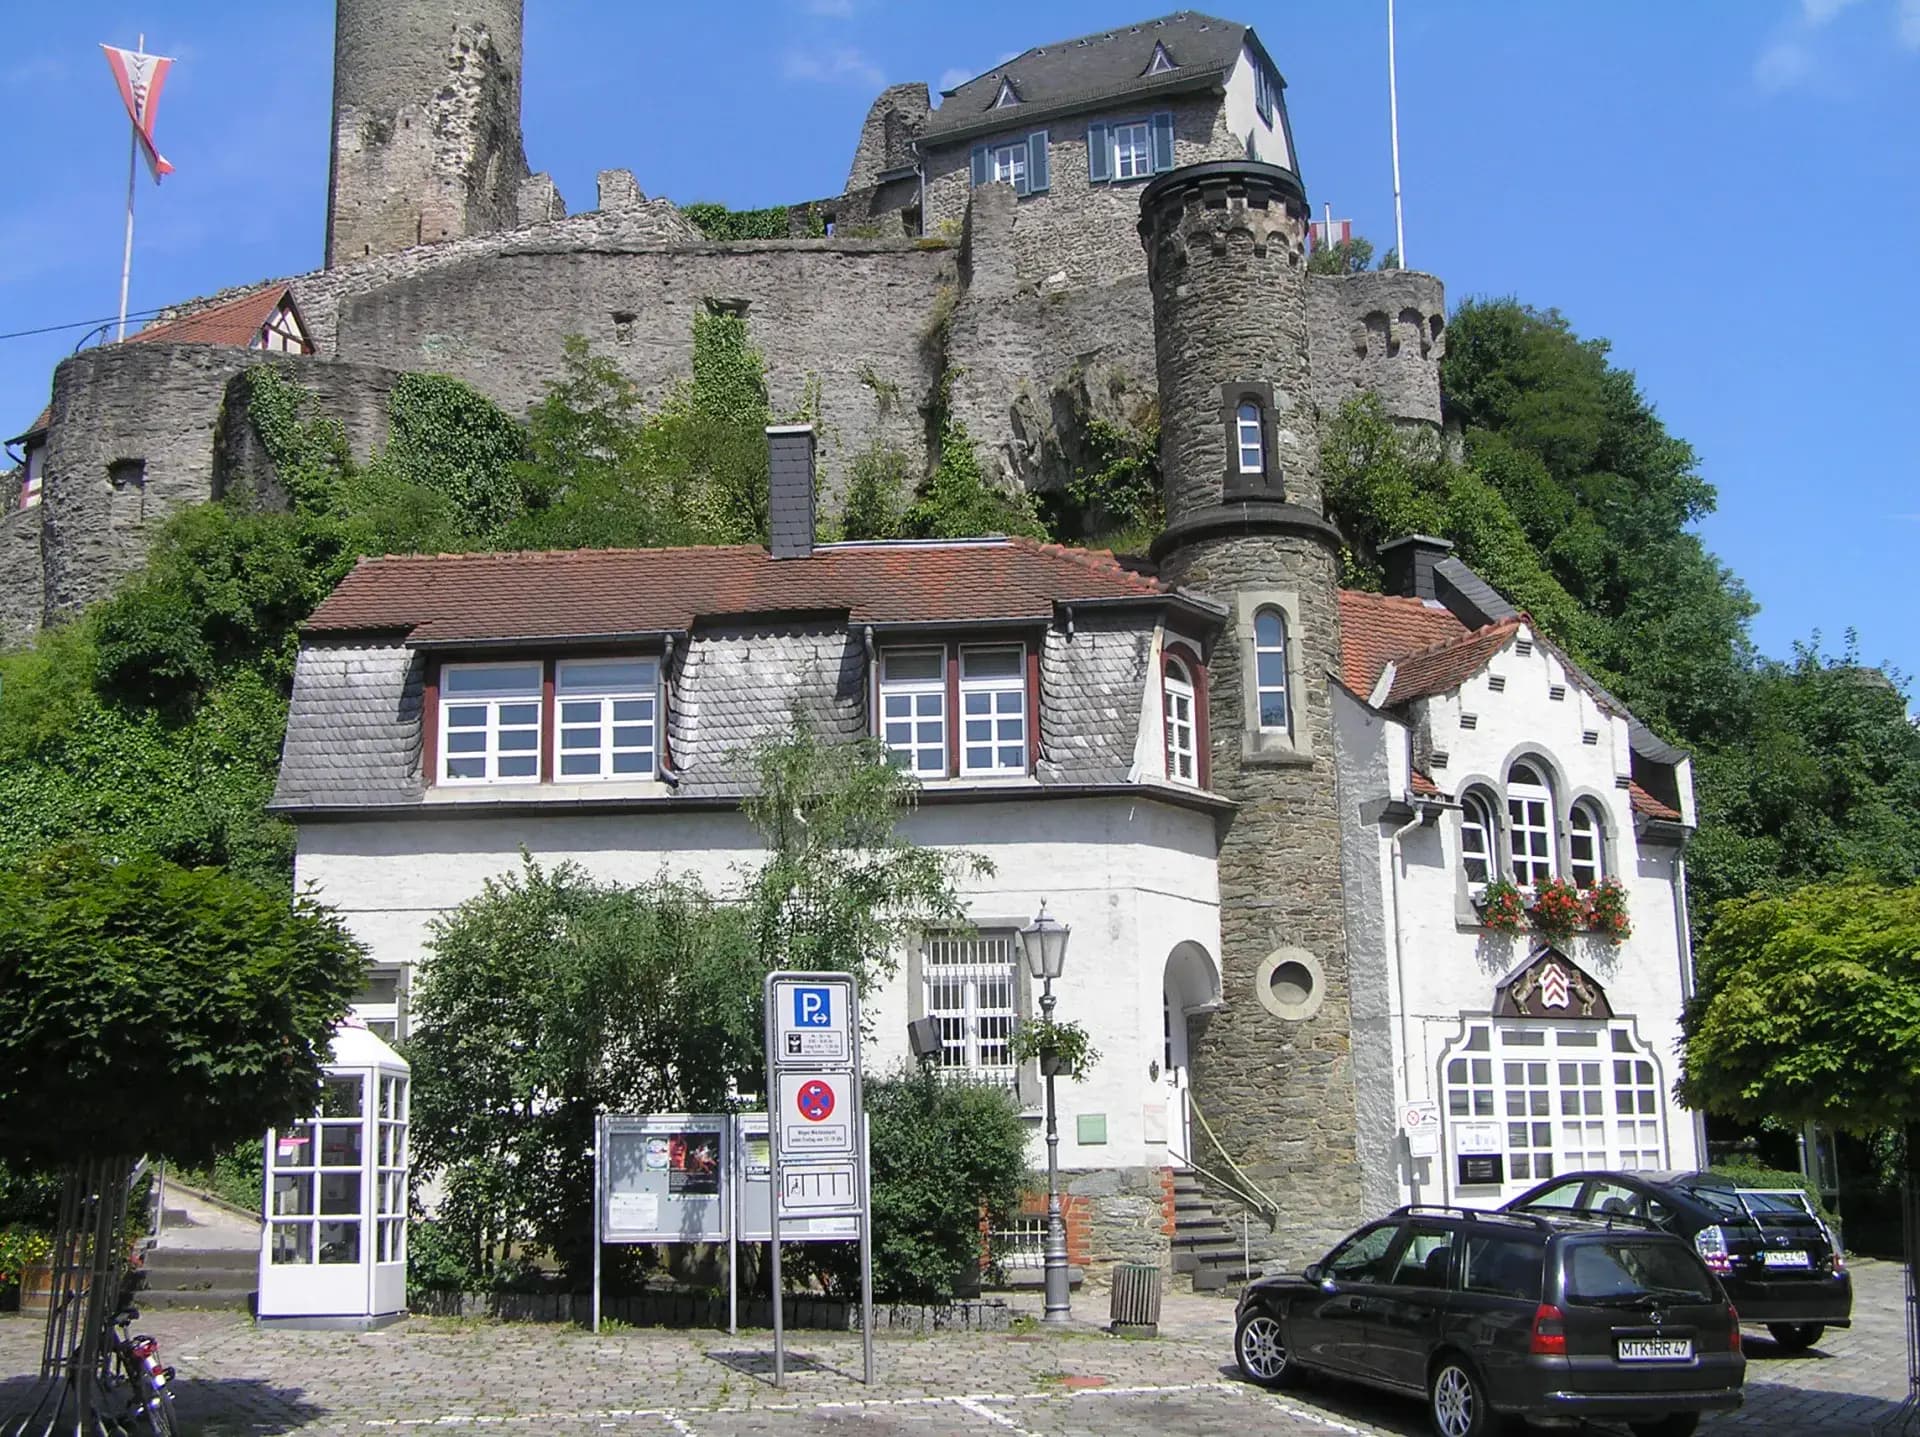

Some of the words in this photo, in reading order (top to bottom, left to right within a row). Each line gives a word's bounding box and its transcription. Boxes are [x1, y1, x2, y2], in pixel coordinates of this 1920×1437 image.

[802, 993, 822, 1022] P
[1621, 1341, 1649, 1356] MTK
[1654, 1341, 1672, 1356] RR
[1674, 1341, 1687, 1355] 47
